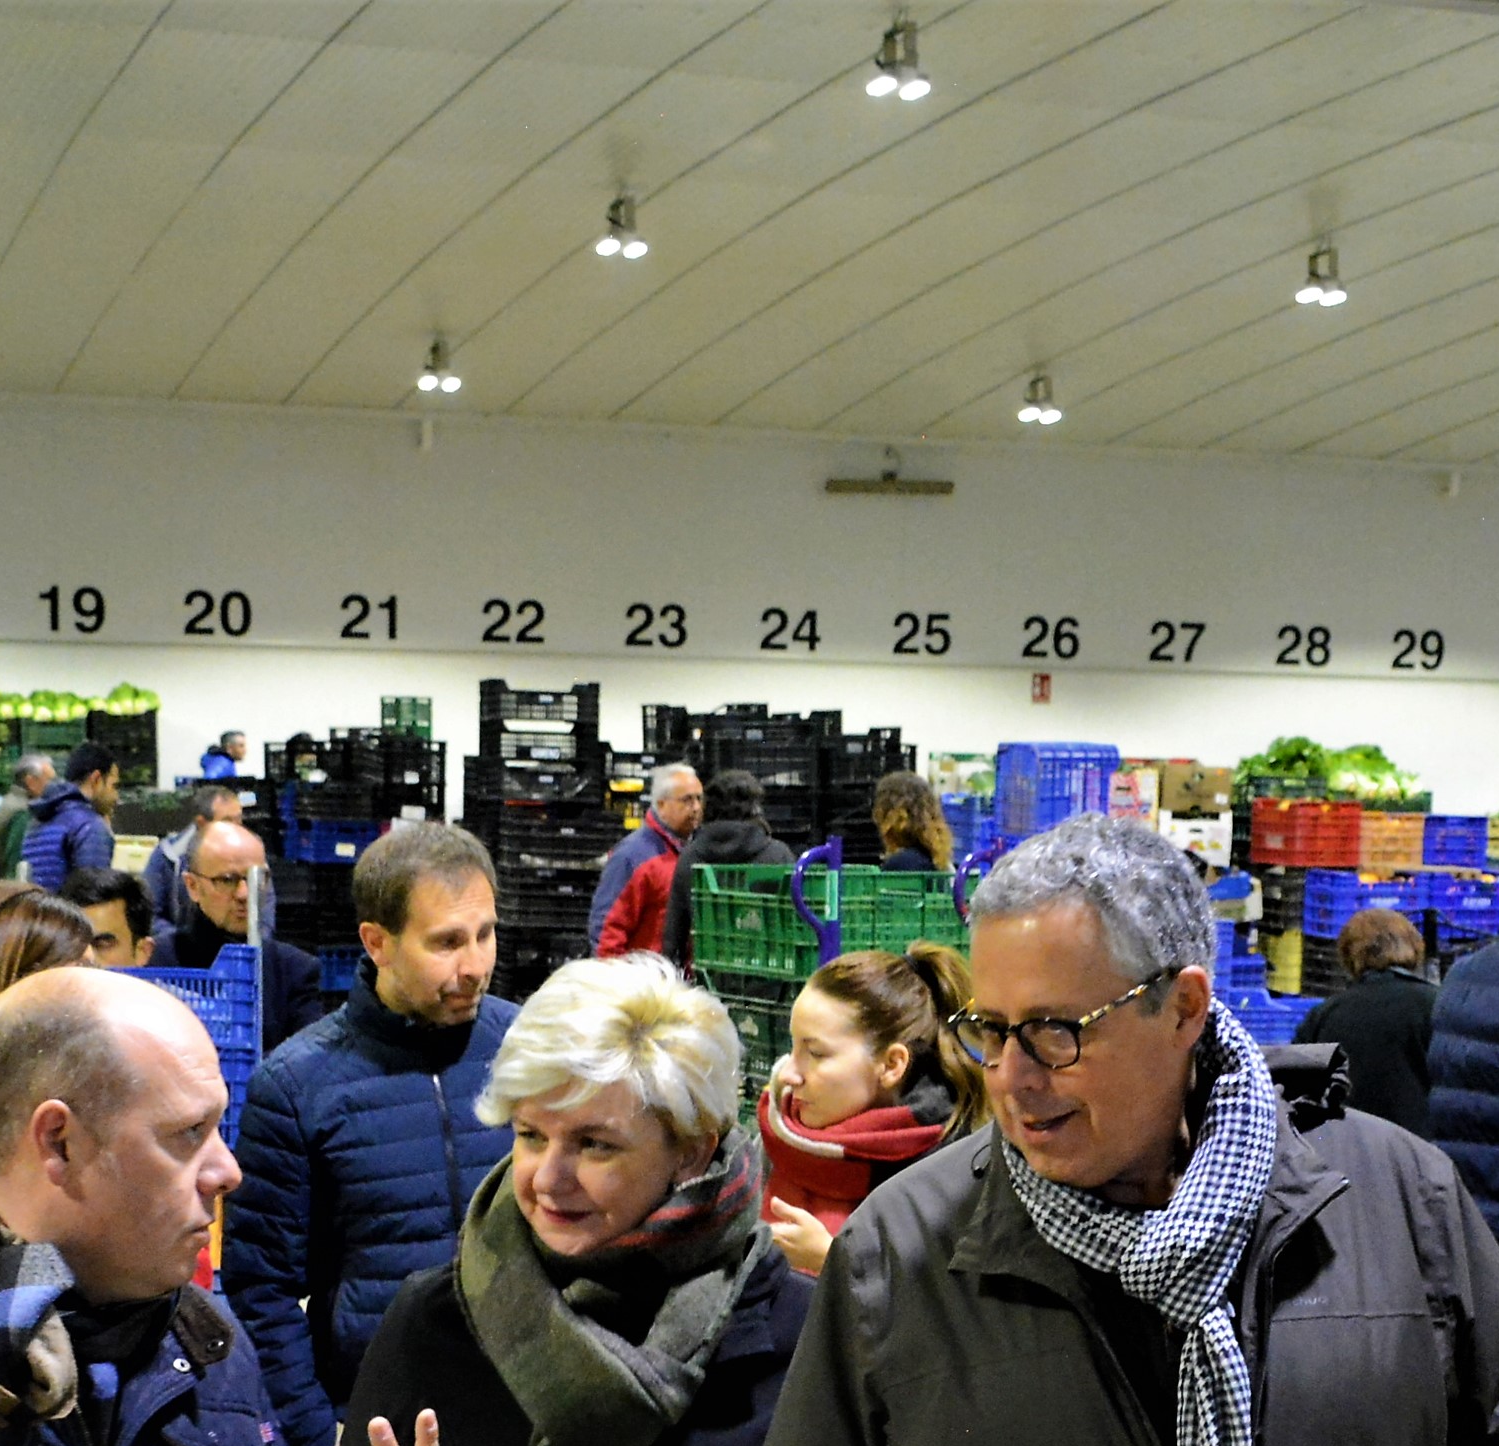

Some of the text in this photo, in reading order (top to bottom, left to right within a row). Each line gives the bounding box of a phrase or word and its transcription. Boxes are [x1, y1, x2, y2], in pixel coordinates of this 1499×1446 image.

[40, 586, 105, 633] 19
[185, 590, 251, 636] 20
[341, 595, 398, 639] 21
[483, 599, 544, 643] 22
[626, 603, 686, 647] 23
[761, 608, 820, 650] 24
[894, 612, 951, 655] 25
[1023, 616, 1079, 659] 26
[1150, 621, 1205, 662] 27
[1277, 625, 1330, 666] 28
[1393, 630, 1444, 669] 29
